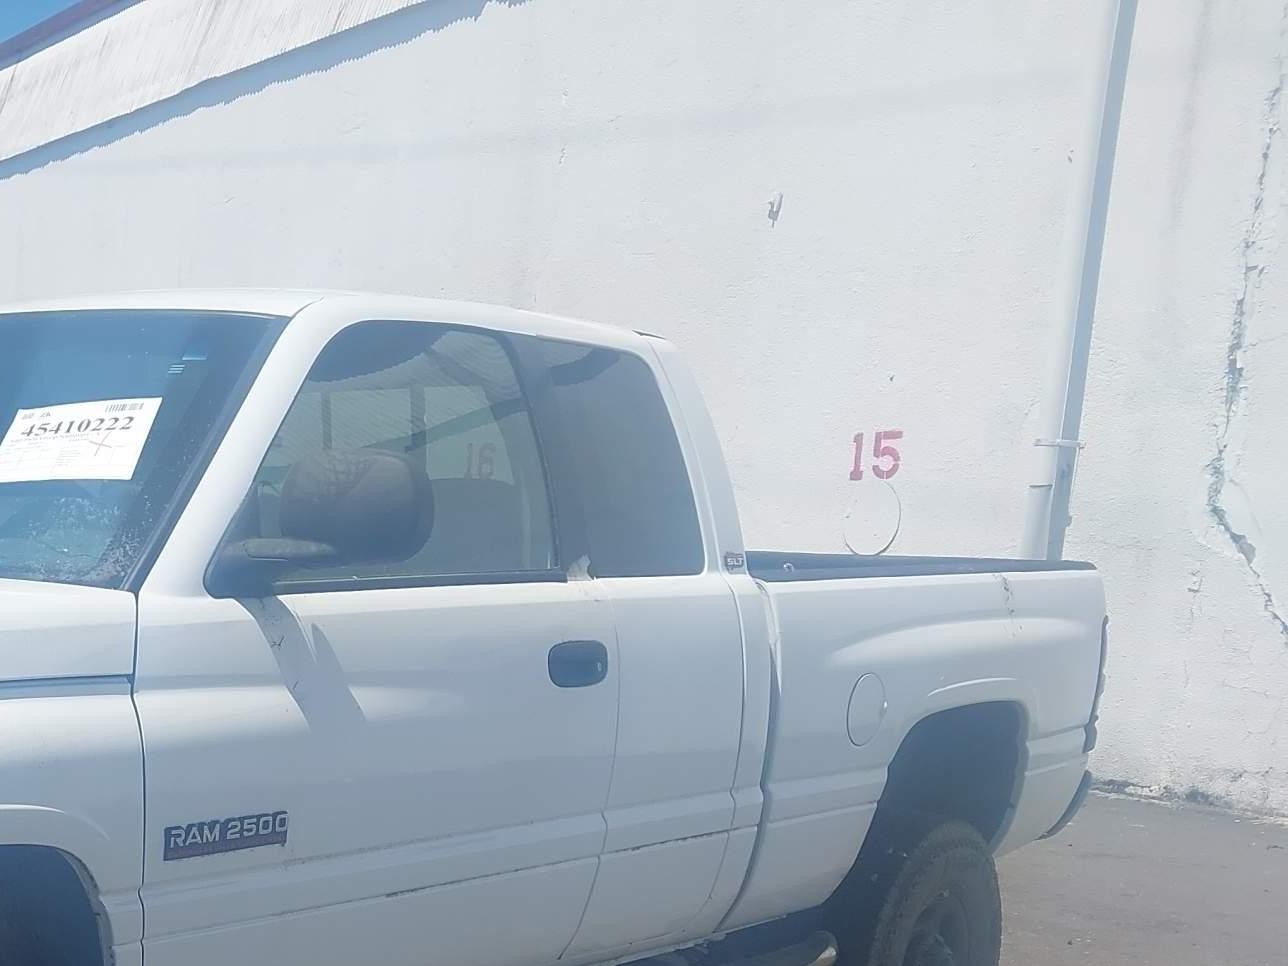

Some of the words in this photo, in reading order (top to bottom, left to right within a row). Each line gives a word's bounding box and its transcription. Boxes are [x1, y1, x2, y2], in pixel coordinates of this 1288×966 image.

[21, 416, 135, 437] 45410222
[849, 430, 904, 481] 15
[169, 822, 220, 848] RAM
[226, 813, 288, 840] 2500
